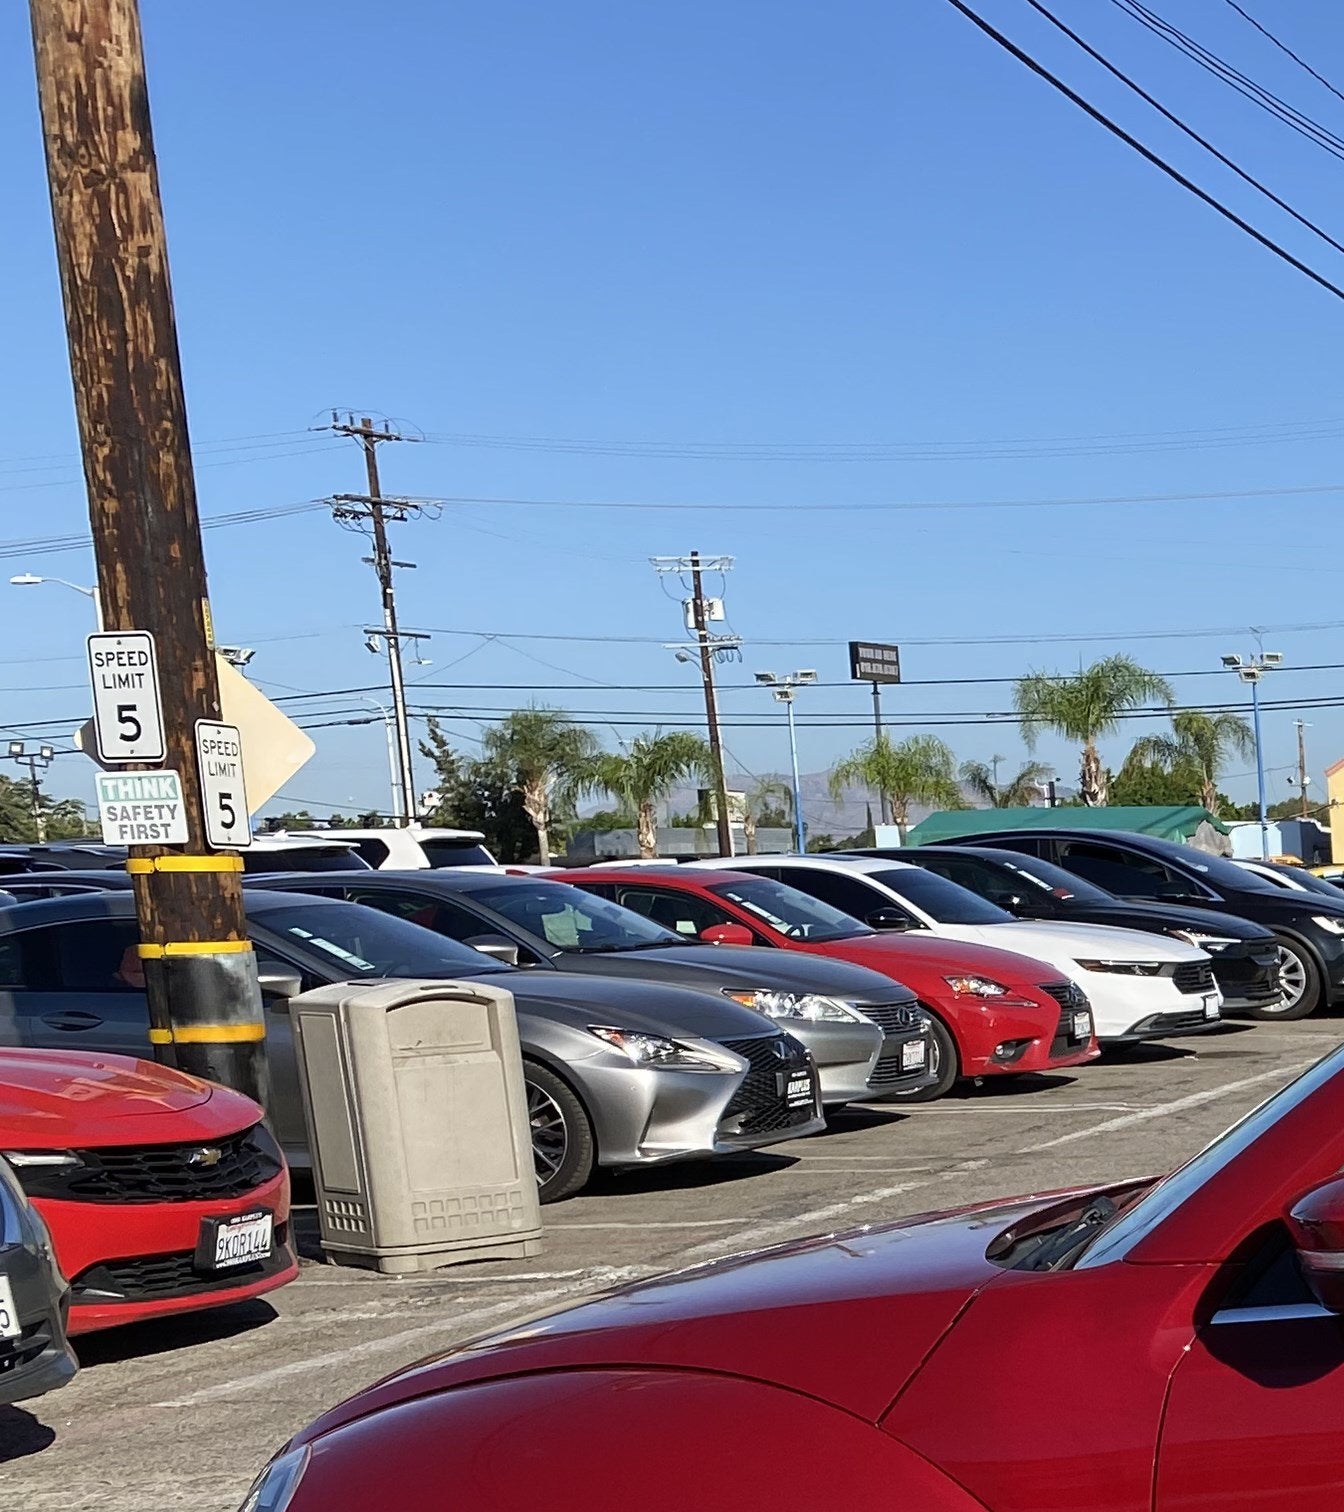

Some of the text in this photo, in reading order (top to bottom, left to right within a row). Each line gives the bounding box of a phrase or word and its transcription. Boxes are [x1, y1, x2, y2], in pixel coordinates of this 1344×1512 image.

[94, 651, 149, 667] SPEED
[102, 673, 145, 690] LIMIT
[116, 703, 142, 742] 5
[202, 739, 239, 757] SPEED
[208, 763, 236, 778] LIMIT
[101, 775, 178, 801] THINK
[107, 804, 178, 822] SAFETY
[218, 792, 236, 830] 5
[119, 823, 172, 840] FIRST
